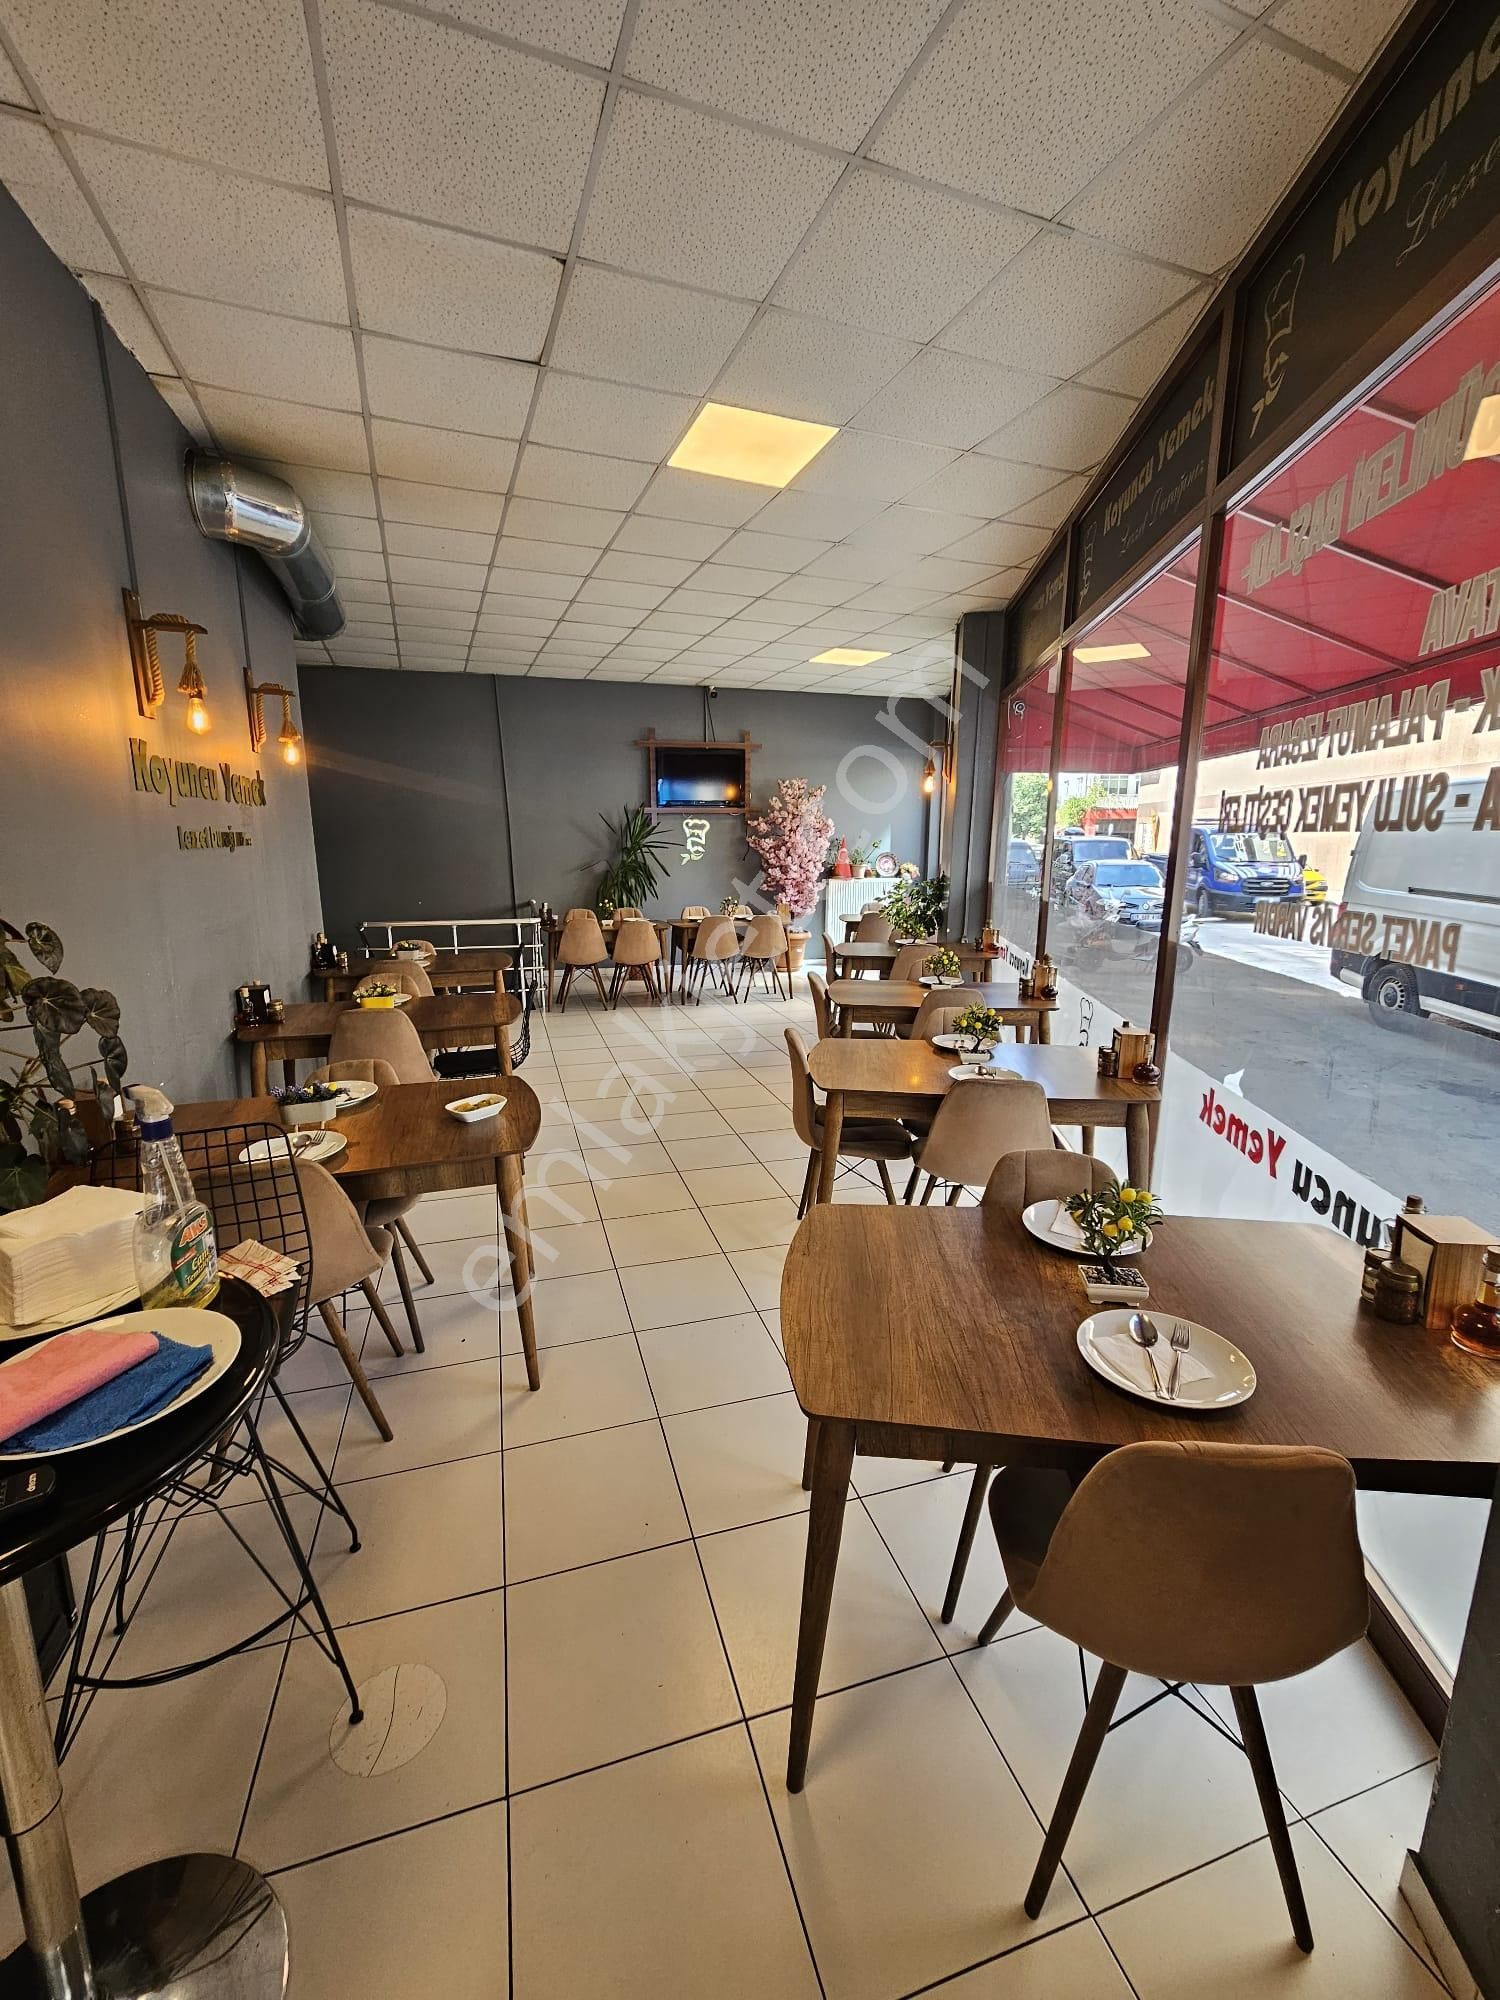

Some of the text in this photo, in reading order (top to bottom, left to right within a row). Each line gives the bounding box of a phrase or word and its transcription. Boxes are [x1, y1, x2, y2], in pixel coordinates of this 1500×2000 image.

[1103, 375, 1215, 537] Koyuncu Yemek
[129, 737, 267, 808] Koyuncu Yemek
